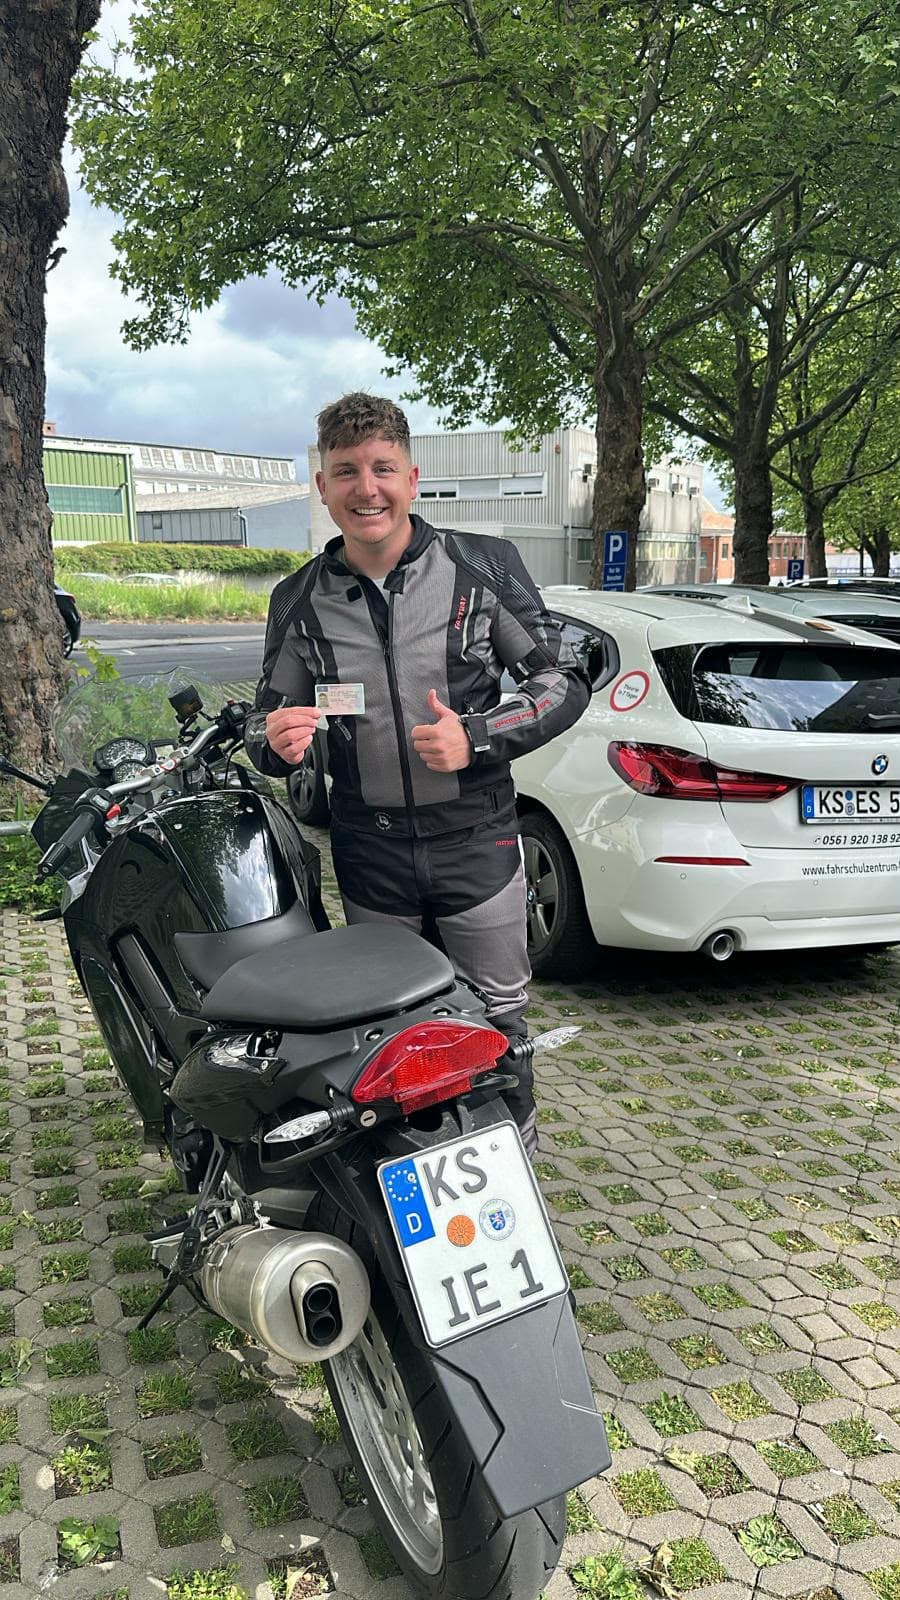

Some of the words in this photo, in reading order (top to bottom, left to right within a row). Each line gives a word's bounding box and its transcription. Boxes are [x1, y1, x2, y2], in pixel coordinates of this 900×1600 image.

[609, 535, 623, 562] P
[790, 562, 801, 578] P
[806, 805, 812, 813] D
[819, 790, 844, 814] KS
[856, 790, 881, 814] ES
[890, 790, 900, 814] 5
[822, 835, 848, 845] 0561
[850, 835, 869, 845] 920
[872, 834, 888, 844] 138
[423, 1147, 488, 1207] KS
[406, 1212, 422, 1234] D
[441, 1262, 501, 1327] IE
[510, 1249, 544, 1298] 1
